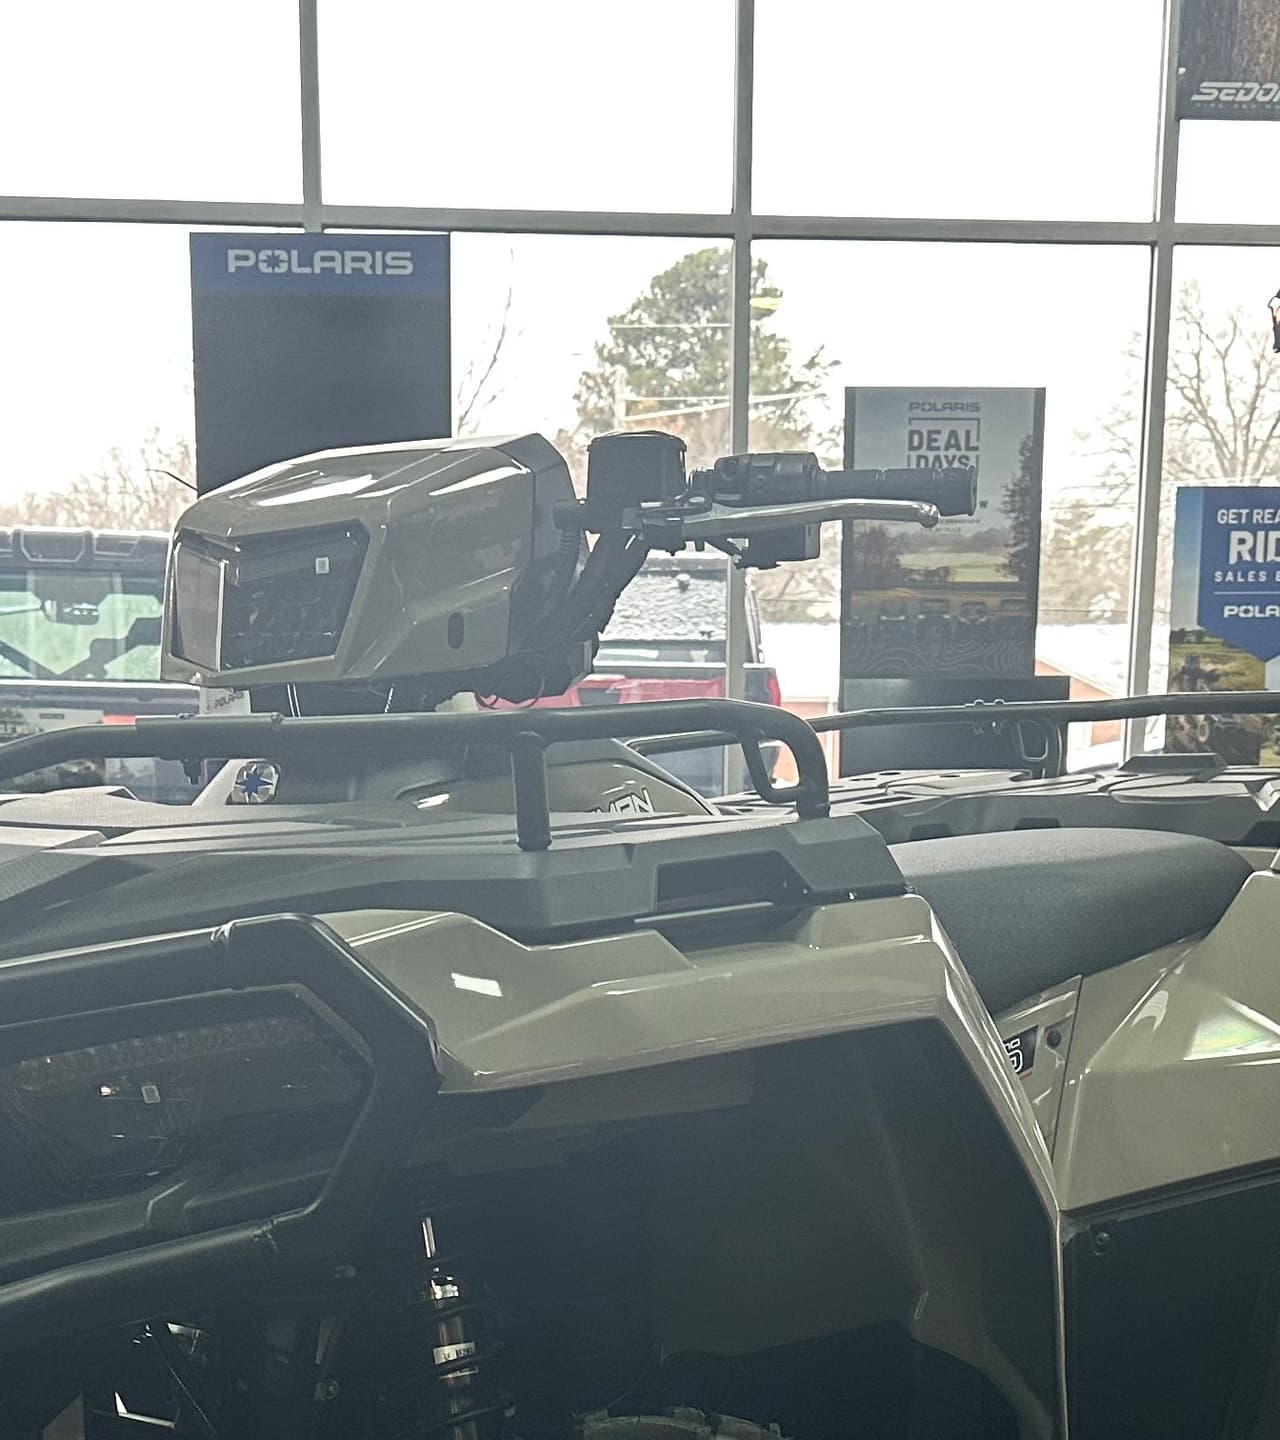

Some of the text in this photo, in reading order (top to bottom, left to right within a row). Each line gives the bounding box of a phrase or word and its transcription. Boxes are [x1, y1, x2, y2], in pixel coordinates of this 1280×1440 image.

[227, 249, 414, 275] POLARIS
[908, 402, 981, 413] POLARIS
[908, 429, 980, 451] DEAL
[917, 455, 971, 468] DAYS
[1217, 508, 1249, 524] GET
[1214, 571, 1267, 582] SALES
